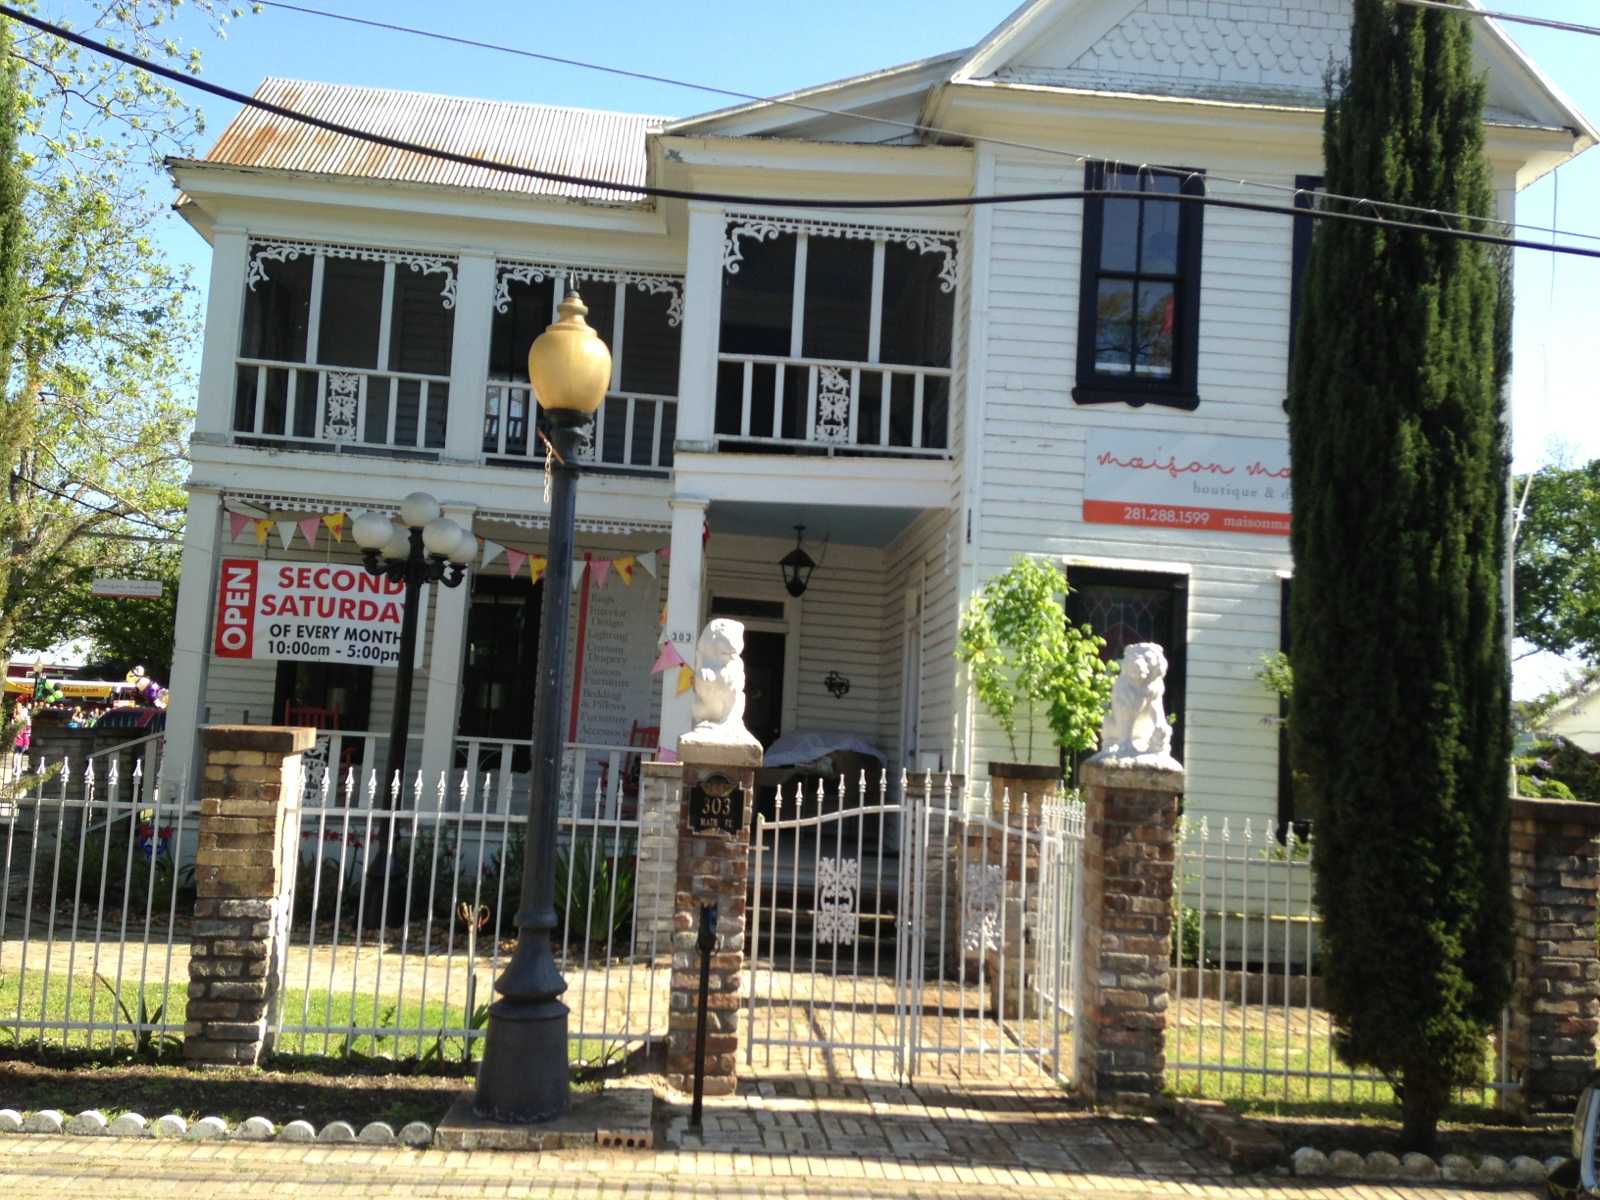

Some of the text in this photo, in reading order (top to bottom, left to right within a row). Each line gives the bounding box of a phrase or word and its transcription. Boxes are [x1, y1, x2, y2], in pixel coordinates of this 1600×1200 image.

[1096, 446, 1235, 478] maison
[1193, 481, 1258, 499] boutique
[1264, 487, 1275, 499] &
[1124, 507, 1292, 530] 281.288.1599 maisonma
[278, 567, 405, 595] SECOND
[591, 593, 615, 605] Rugs
[221, 567, 252, 650] OPEN
[260, 594, 406, 624] SATURDA
[590, 606, 627, 617] Interior
[591, 617, 624, 629] Design
[269, 624, 401, 645] OF EVERY MONTH
[588, 629, 628, 643] Lighting
[672, 632, 692, 642] 303
[268, 640, 330, 656] 10:00am
[586, 642, 624, 654] Custom
[589, 652, 628, 667] Drapery
[584, 665, 622, 677] Custom
[584, 675, 631, 688] Furniture
[583, 688, 622, 702] Bedding
[592, 699, 627, 711] Pillows
[581, 712, 628, 724] Furniture
[702, 797, 731, 815] 303
[700, 817, 718, 827] MAIN
